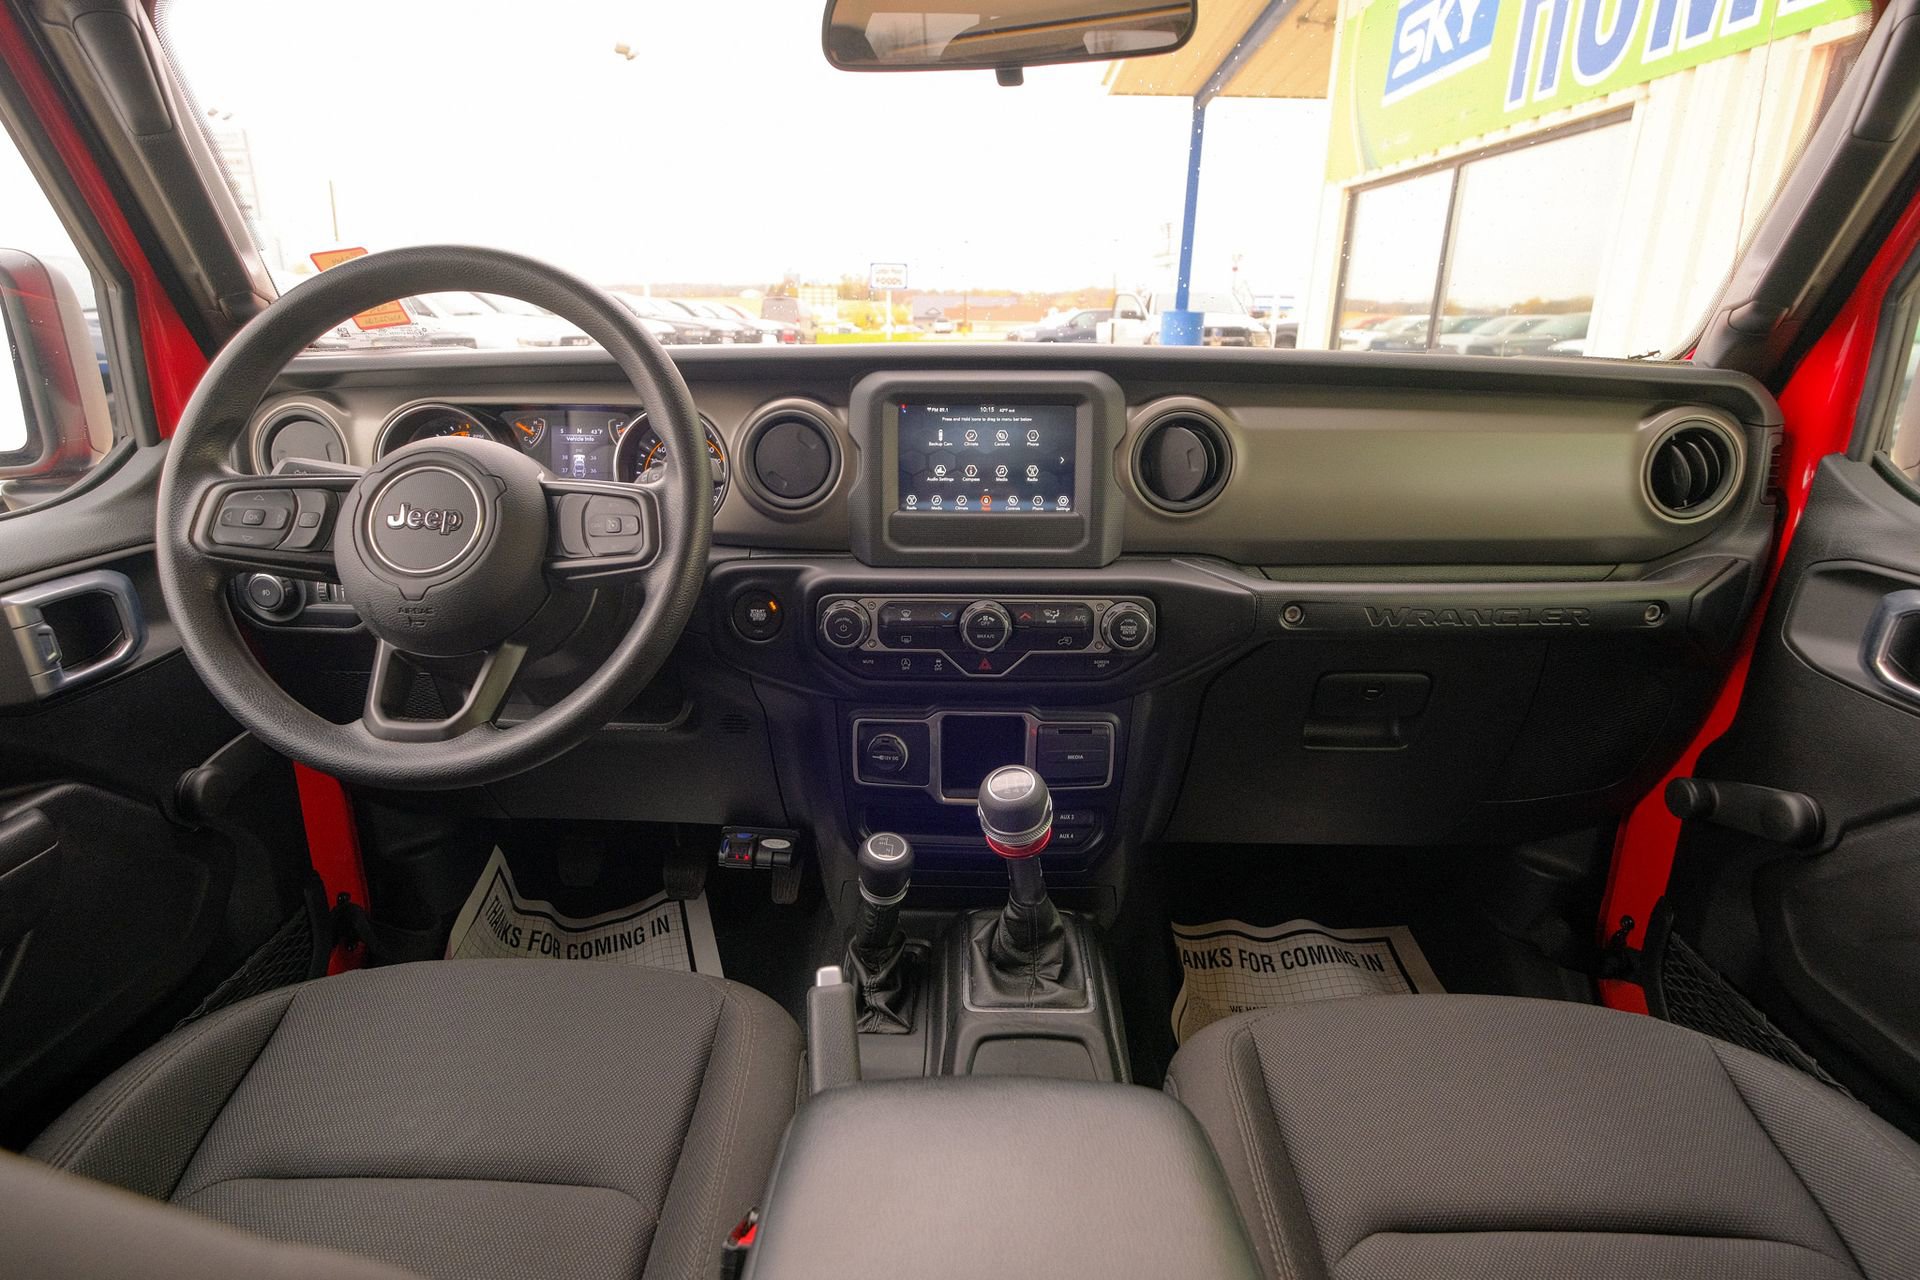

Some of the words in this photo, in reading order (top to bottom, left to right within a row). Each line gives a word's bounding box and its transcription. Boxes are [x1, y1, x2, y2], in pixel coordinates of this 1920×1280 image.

[1392, 0, 1484, 80] SKY
[387, 502, 463, 535] Jeep
[1074, 614, 1086, 622] A/C
[1363, 606, 1592, 628] WRANGLER
[485, 895, 522, 949] THANKS
[528, 930, 561, 960] FOR
[566, 926, 645, 962] COMING
[652, 914, 671, 938] IN
[1180, 948, 1233, 970] ANKS
[1239, 948, 1276, 974] FOR
[1280, 945, 1358, 971] COMING
[1362, 953, 1386, 973] IN
